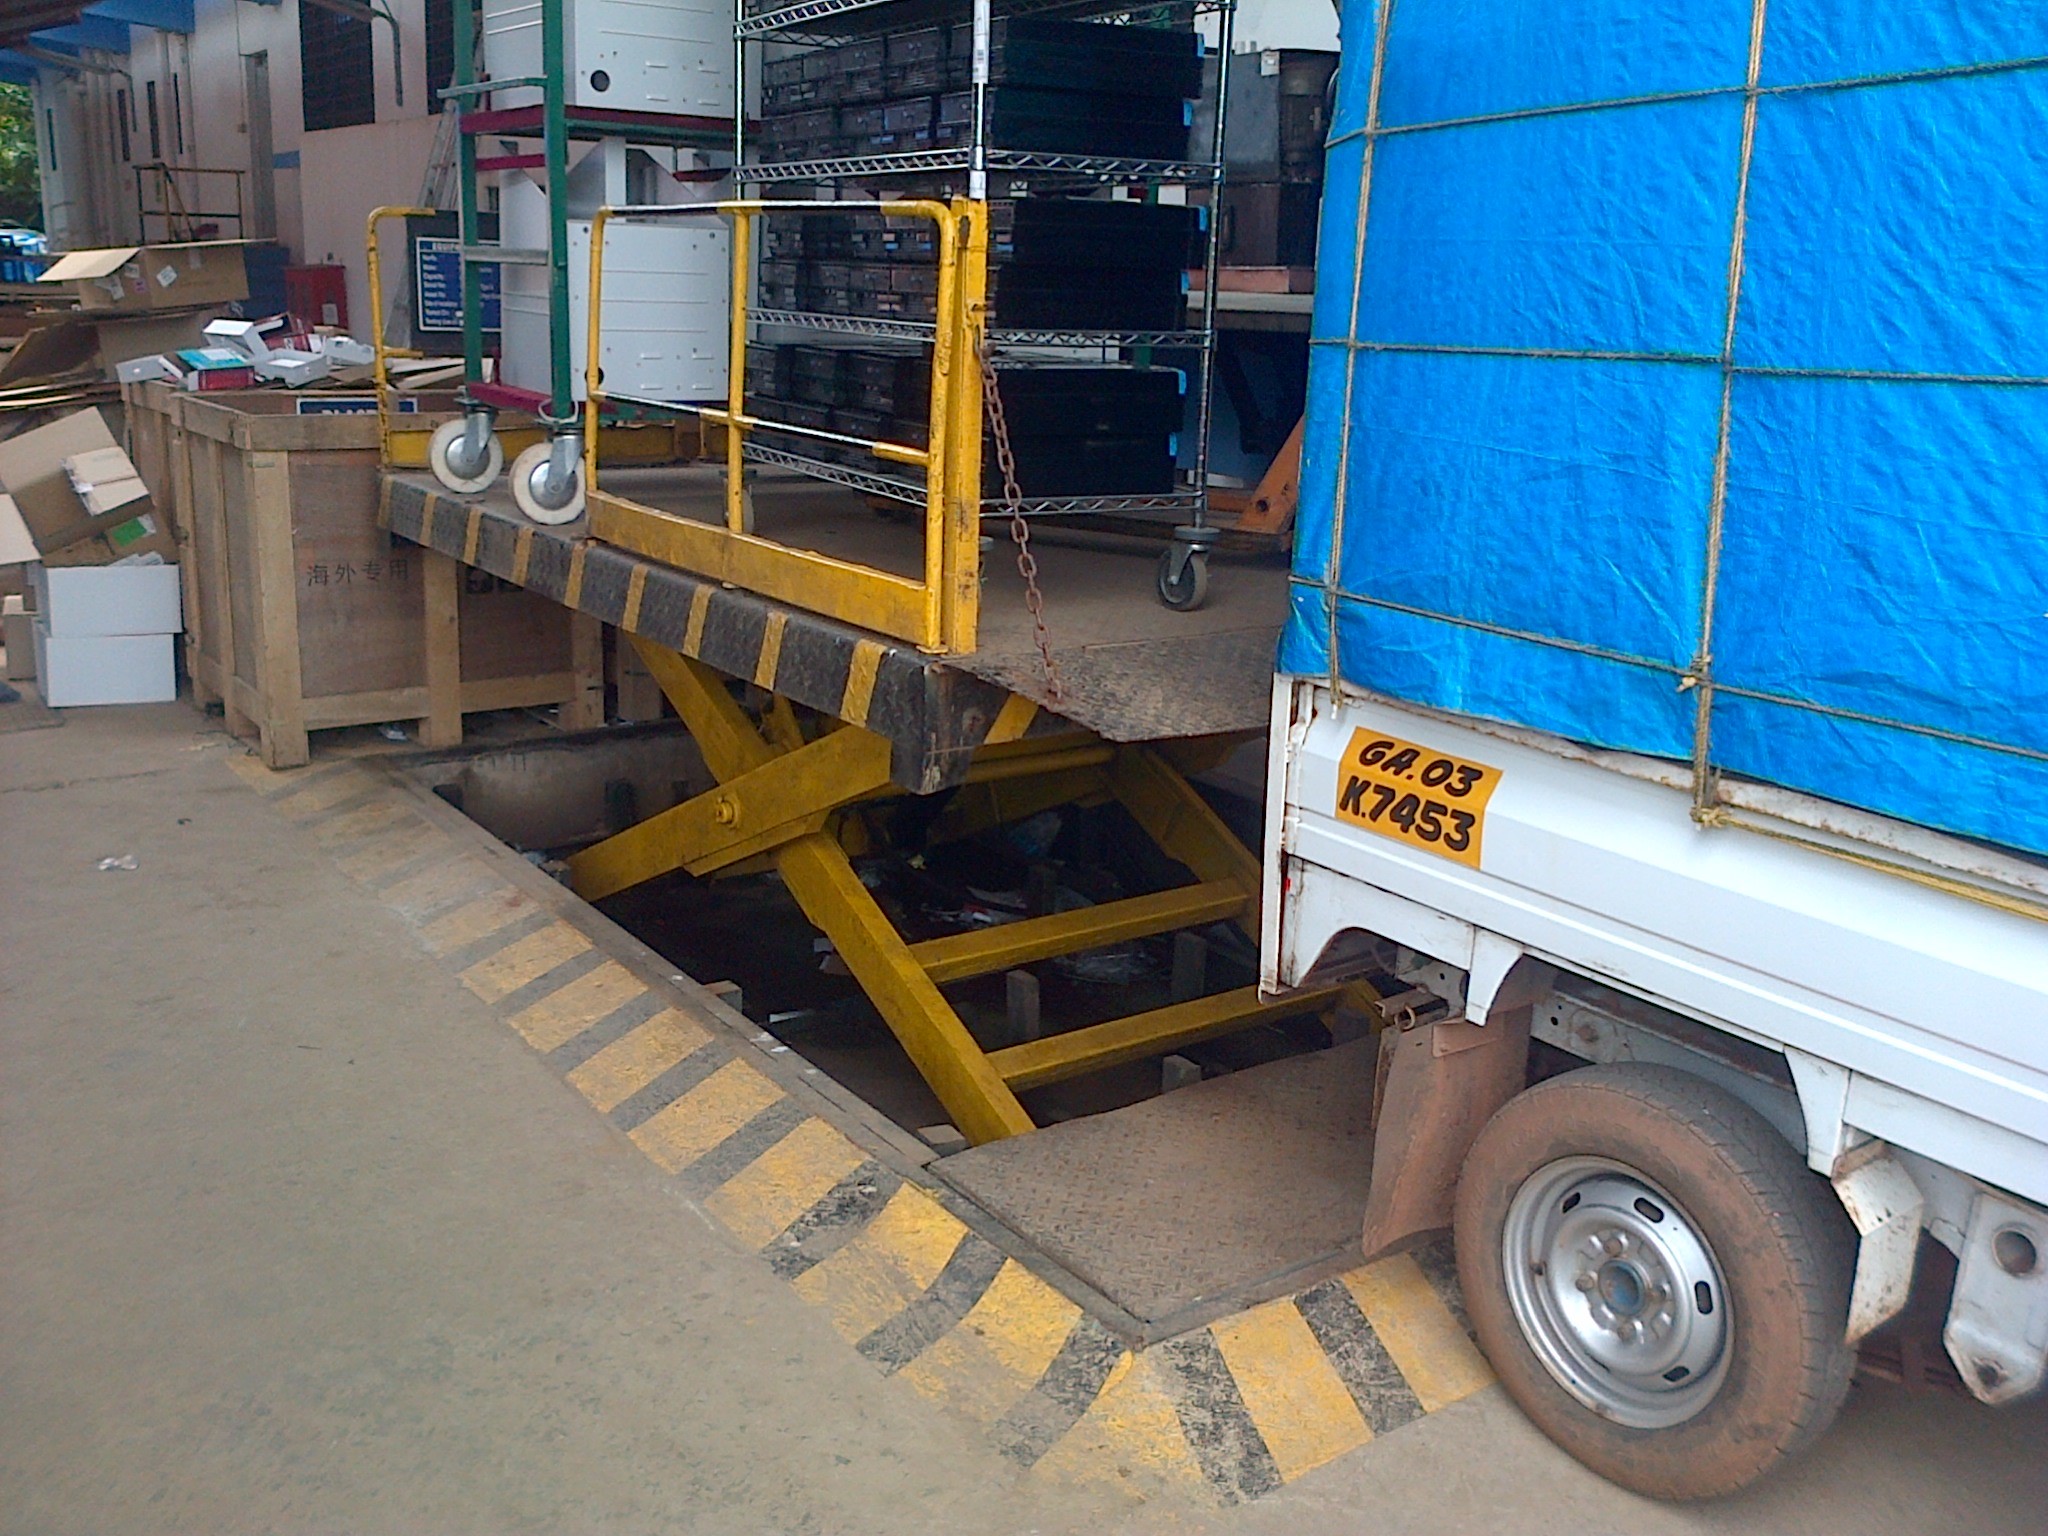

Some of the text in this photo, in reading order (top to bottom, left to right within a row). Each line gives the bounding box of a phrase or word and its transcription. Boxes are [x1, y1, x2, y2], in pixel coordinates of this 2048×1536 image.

[307, 559, 409, 587] 海外专用
[1359, 740, 1483, 797] GA.03
[1339, 775, 1476, 852] K.7453
